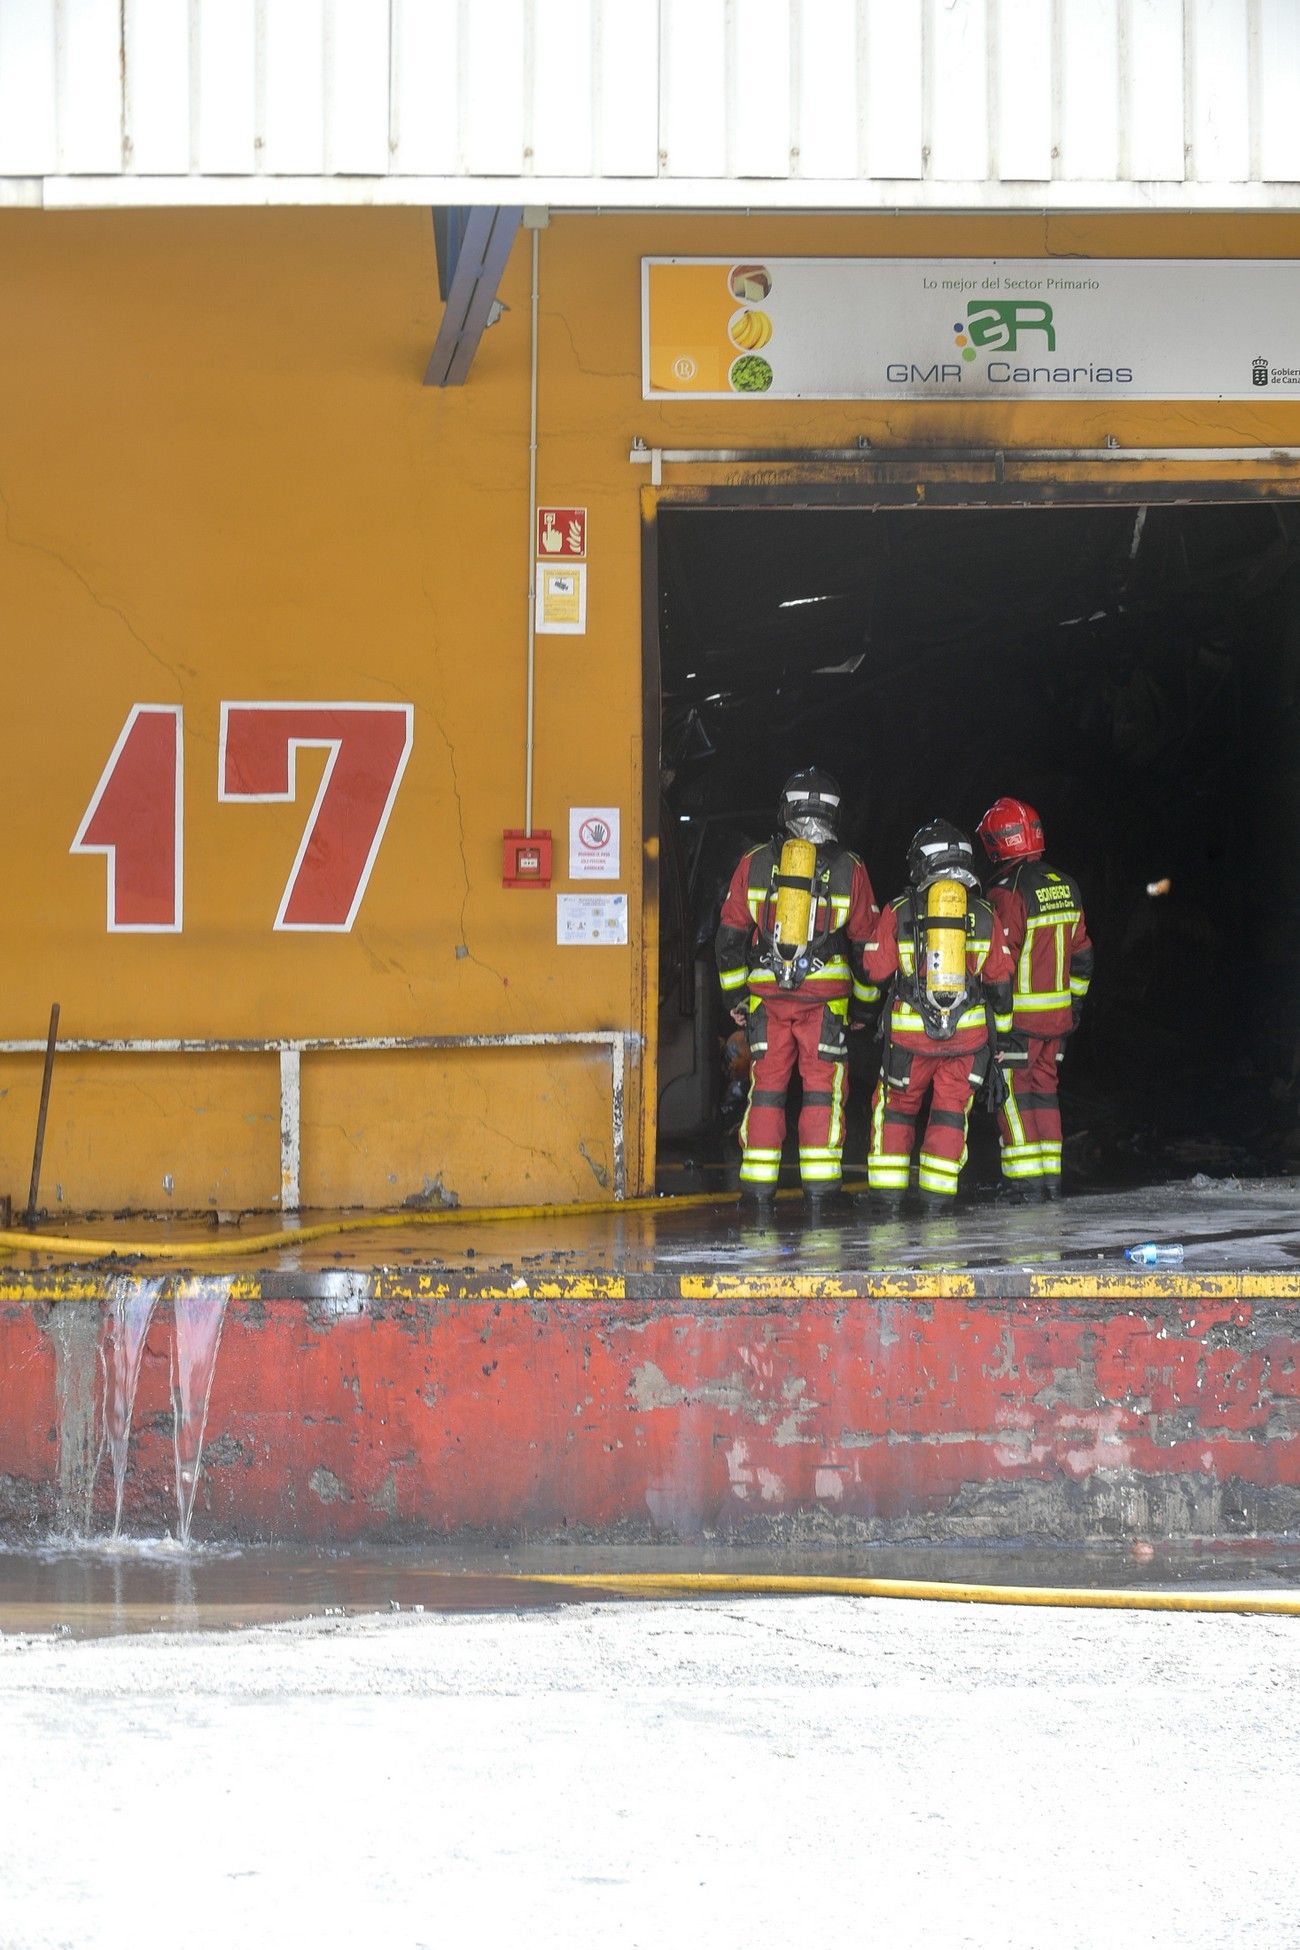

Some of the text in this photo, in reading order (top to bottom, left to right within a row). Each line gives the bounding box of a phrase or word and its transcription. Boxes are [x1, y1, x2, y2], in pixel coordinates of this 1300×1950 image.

[923, 277, 1100, 293] Lo mejor del Sector Primario
[886, 362, 1133, 383] GMR Canarias
[69, 701, 415, 934] 17
